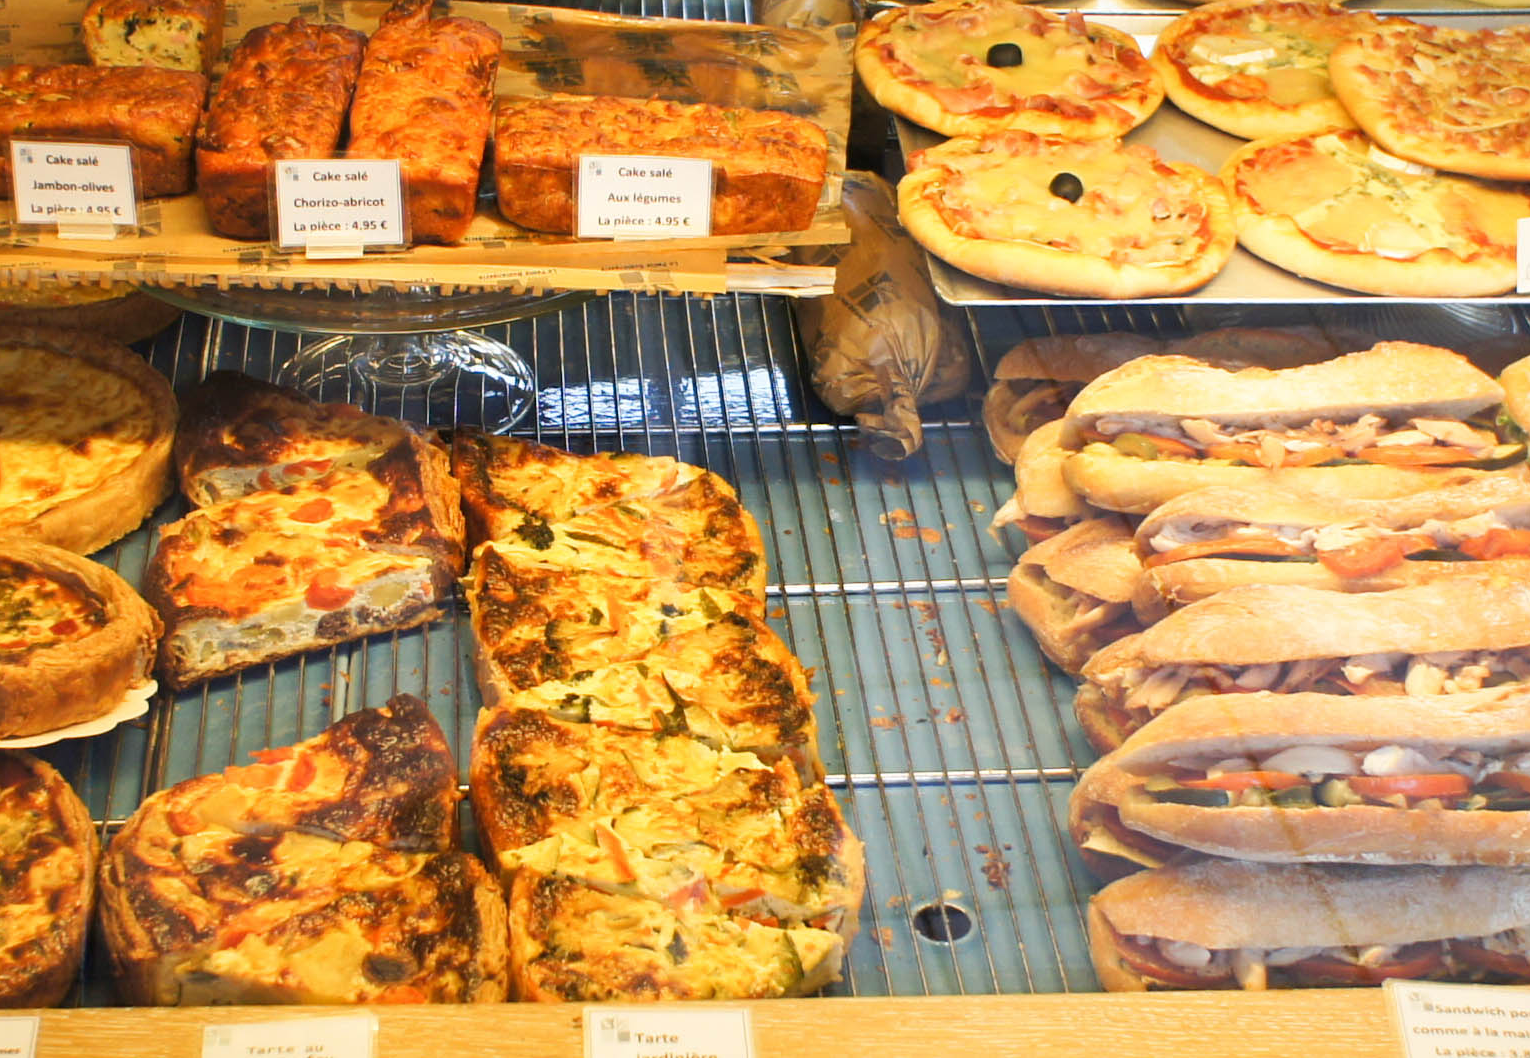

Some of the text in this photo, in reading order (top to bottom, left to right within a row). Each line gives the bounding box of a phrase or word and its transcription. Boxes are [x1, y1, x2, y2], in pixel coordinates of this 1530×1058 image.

[46, 154, 99, 167] Cake salé
[312, 170, 369, 182] Cake salé
[618, 166, 673, 179] Cake salé
[32, 179, 115, 193] Jambon-olives
[293, 196, 386, 208] Chorizo-abricot
[607, 192, 682, 205] Aux légumes
[31, 203, 43, 214] La
[113, 206, 123, 217] €
[293, 221, 306, 232] La
[310, 220, 341, 232] pièce
[351, 219, 377, 231] 4.95
[380, 220, 389, 231] €
[598, 216, 611, 226] La
[614, 215, 645, 228] pièce
[654, 216, 680, 227] 4.95
[682, 216, 691, 227] €
[1434, 1004, 1506, 1016] Sandwich
[635, 1032, 679, 1044] Tarte
[1412, 1025, 1469, 1036] comme
[1484, 1026, 1499, 1038] la
[1434, 1046, 1452, 1057] La
[1455, 1047, 1497, 1058] pièce
